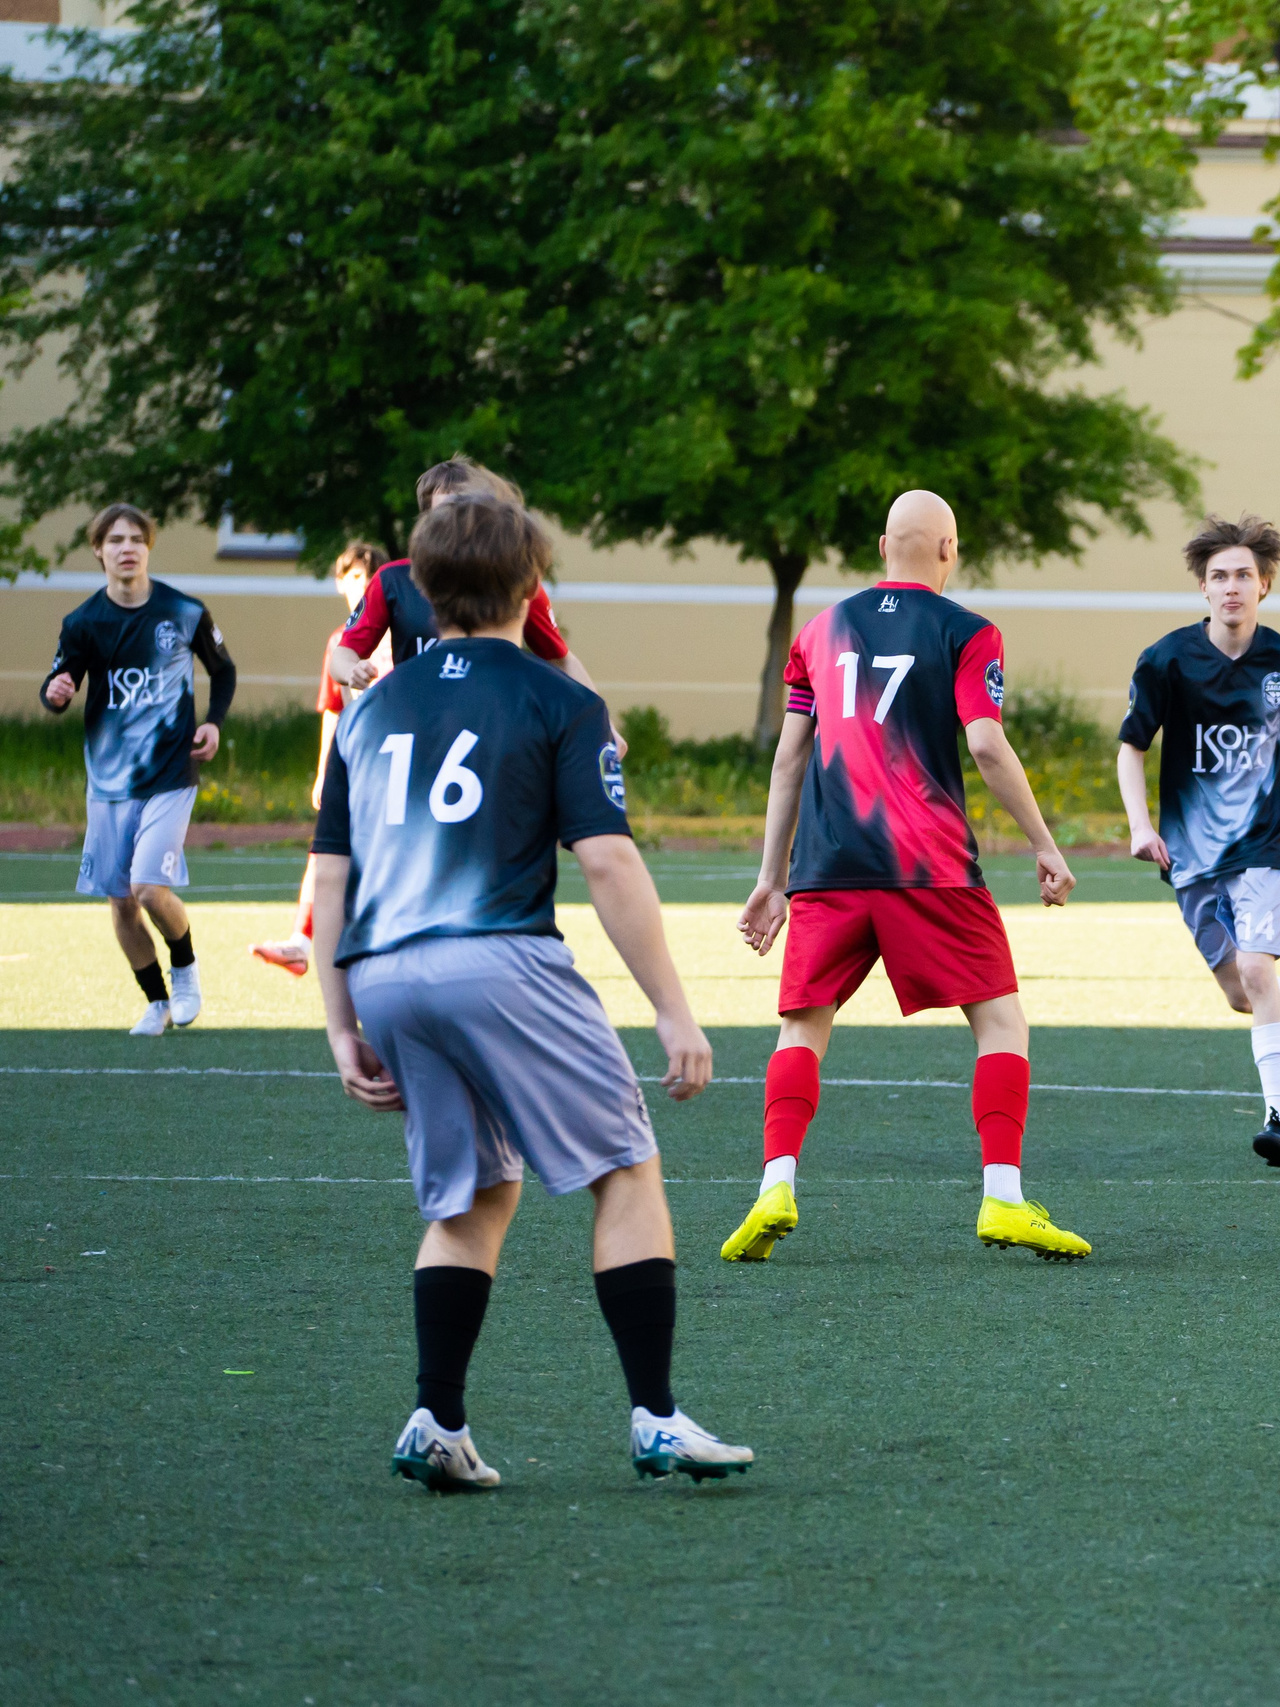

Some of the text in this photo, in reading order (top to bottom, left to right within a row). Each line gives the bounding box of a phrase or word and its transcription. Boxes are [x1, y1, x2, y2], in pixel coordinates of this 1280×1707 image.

[835, 651, 916, 726] 17
[378, 728, 484, 825] 16
[160, 850, 175, 876] 8
[1240, 910, 1275, 941] 14
